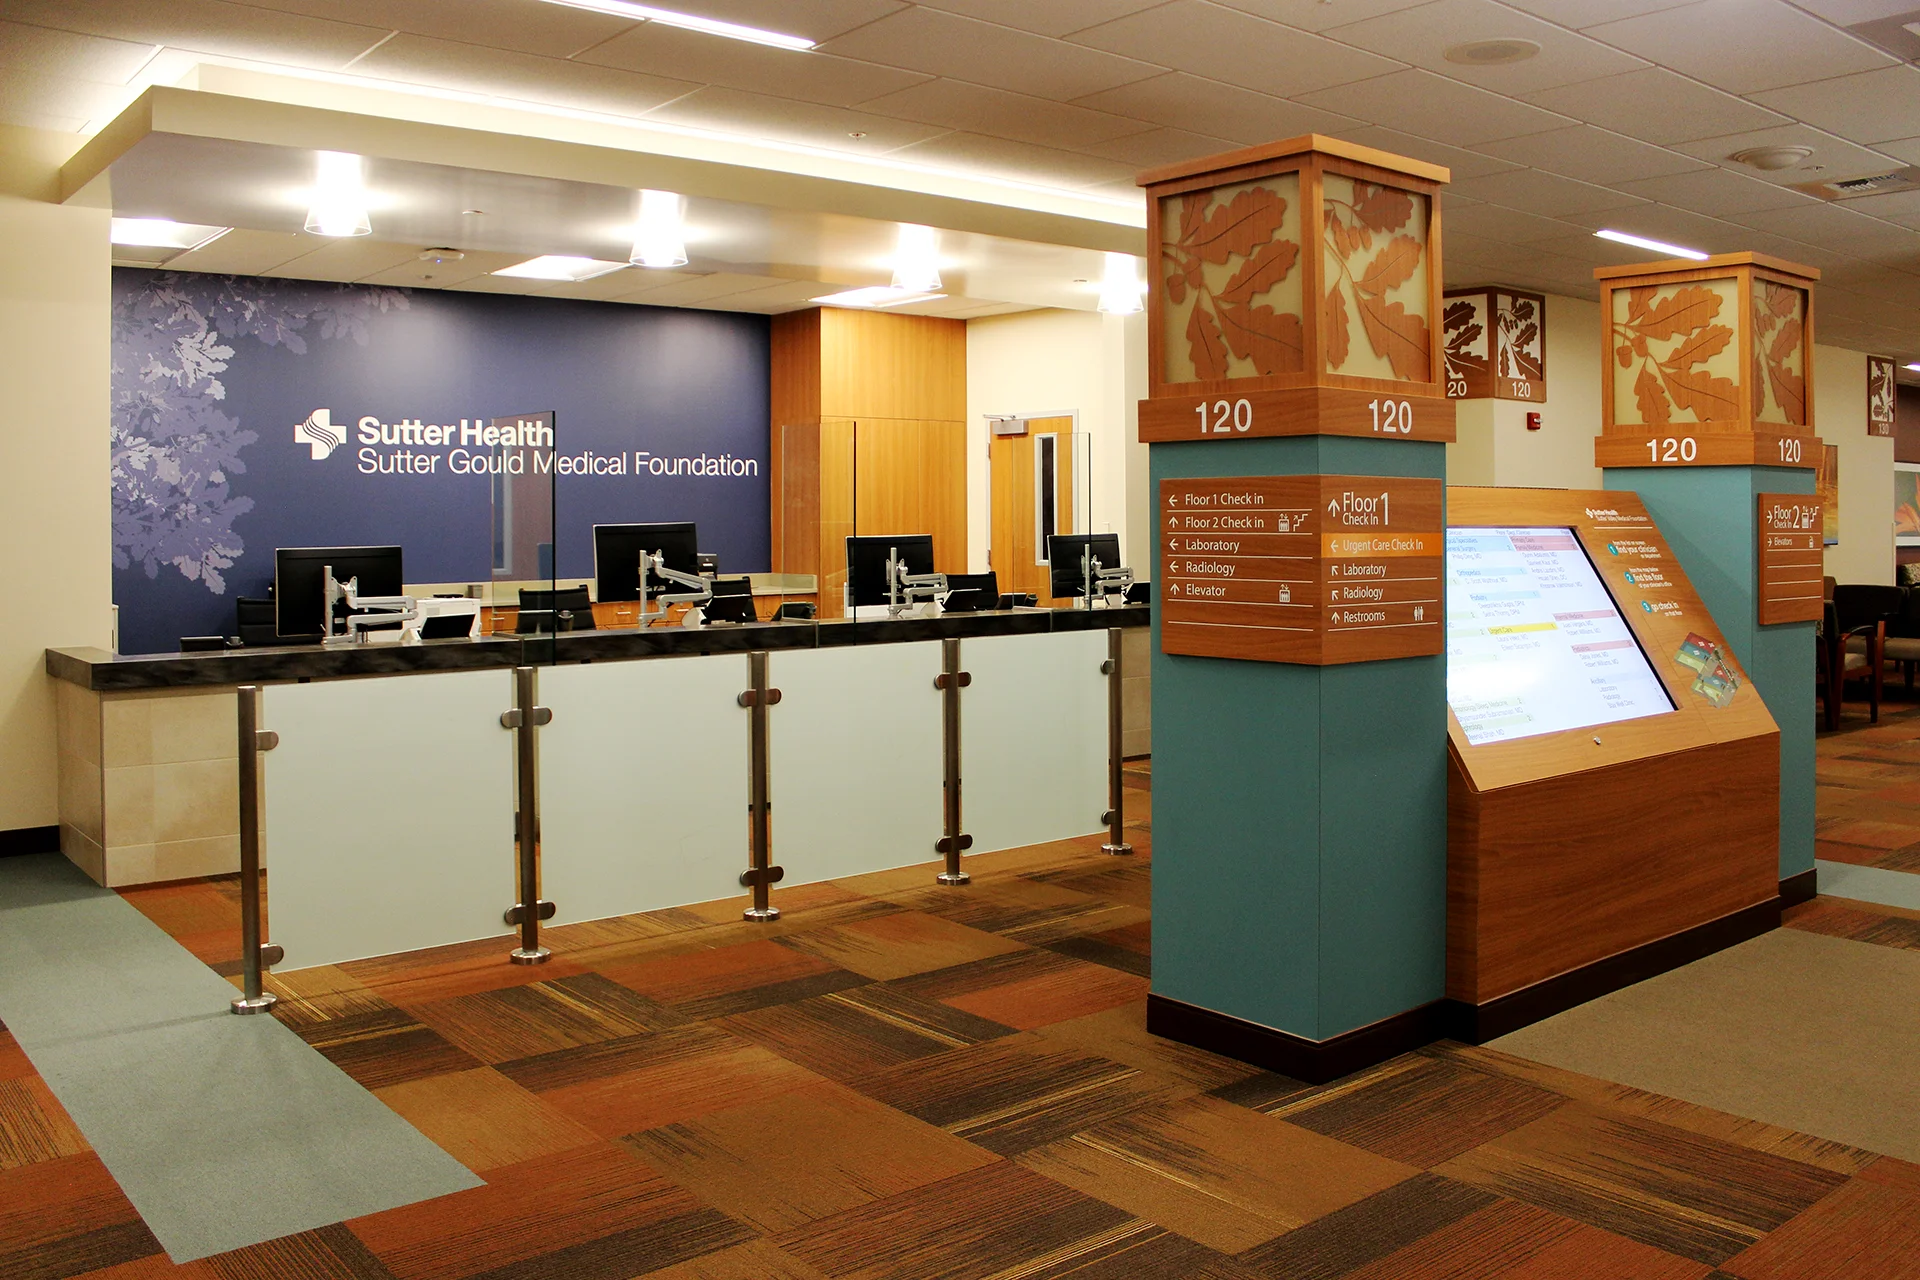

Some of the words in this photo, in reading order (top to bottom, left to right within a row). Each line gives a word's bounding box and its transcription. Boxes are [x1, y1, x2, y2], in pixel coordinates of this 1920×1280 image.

[1447, 380, 1467, 397] 20
[1512, 381, 1531, 398] 120
[1195, 399, 1252, 434] 120
[1368, 399, 1412, 434] 120
[357, 415, 455, 446] Sutter
[460, 418, 554, 447] Health
[1646, 437, 1697, 462] 120
[1778, 438, 1801, 463] 120
[357, 447, 440, 474] Sutter
[448, 448, 524, 475] Gould
[534, 451, 626, 476] Medical
[635, 452, 758, 477] Foundation
[1185, 493, 1210, 506] Floor
[1212, 493, 1217, 505] 1
[1220, 492, 1251, 505] Check
[1254, 493, 1264, 505] in
[1343, 491, 1378, 512] Floor
[1381, 492, 1389, 525] 1
[1185, 516, 1210, 529] Floor
[1211, 517, 1219, 528] 2
[1220, 516, 1251, 529] Check
[1254, 516, 1264, 528] in
[1342, 512, 1367, 526] Check
[1370, 512, 1378, 525] In
[1774, 504, 1792, 519] Floor
[1792, 506, 1800, 528] 2
[1773, 519, 1787, 529] Check
[1185, 538, 1240, 553] Laboratory
[1343, 539, 1371, 553] Urgent
[1373, 539, 1390, 550] Care
[1391, 538, 1415, 550] Check
[1416, 539, 1423, 550] In
[1774, 536, 1793, 546] Elevators
[1627, 547, 1638, 555] your
[1186, 561, 1235, 577] Radiology
[1343, 563, 1386, 578] Laboratory
[1626, 573, 1633, 582] 2
[1643, 573, 1652, 581] the
[1186, 583, 1226, 597] Elevator
[1343, 586, 1383, 601] Radiology
[1643, 602, 1650, 611] 3
[1651, 604, 1659, 612] go
[1658, 602, 1674, 610] check
[1672, 601, 1679, 609] in
[1343, 610, 1385, 623] Restrooms
